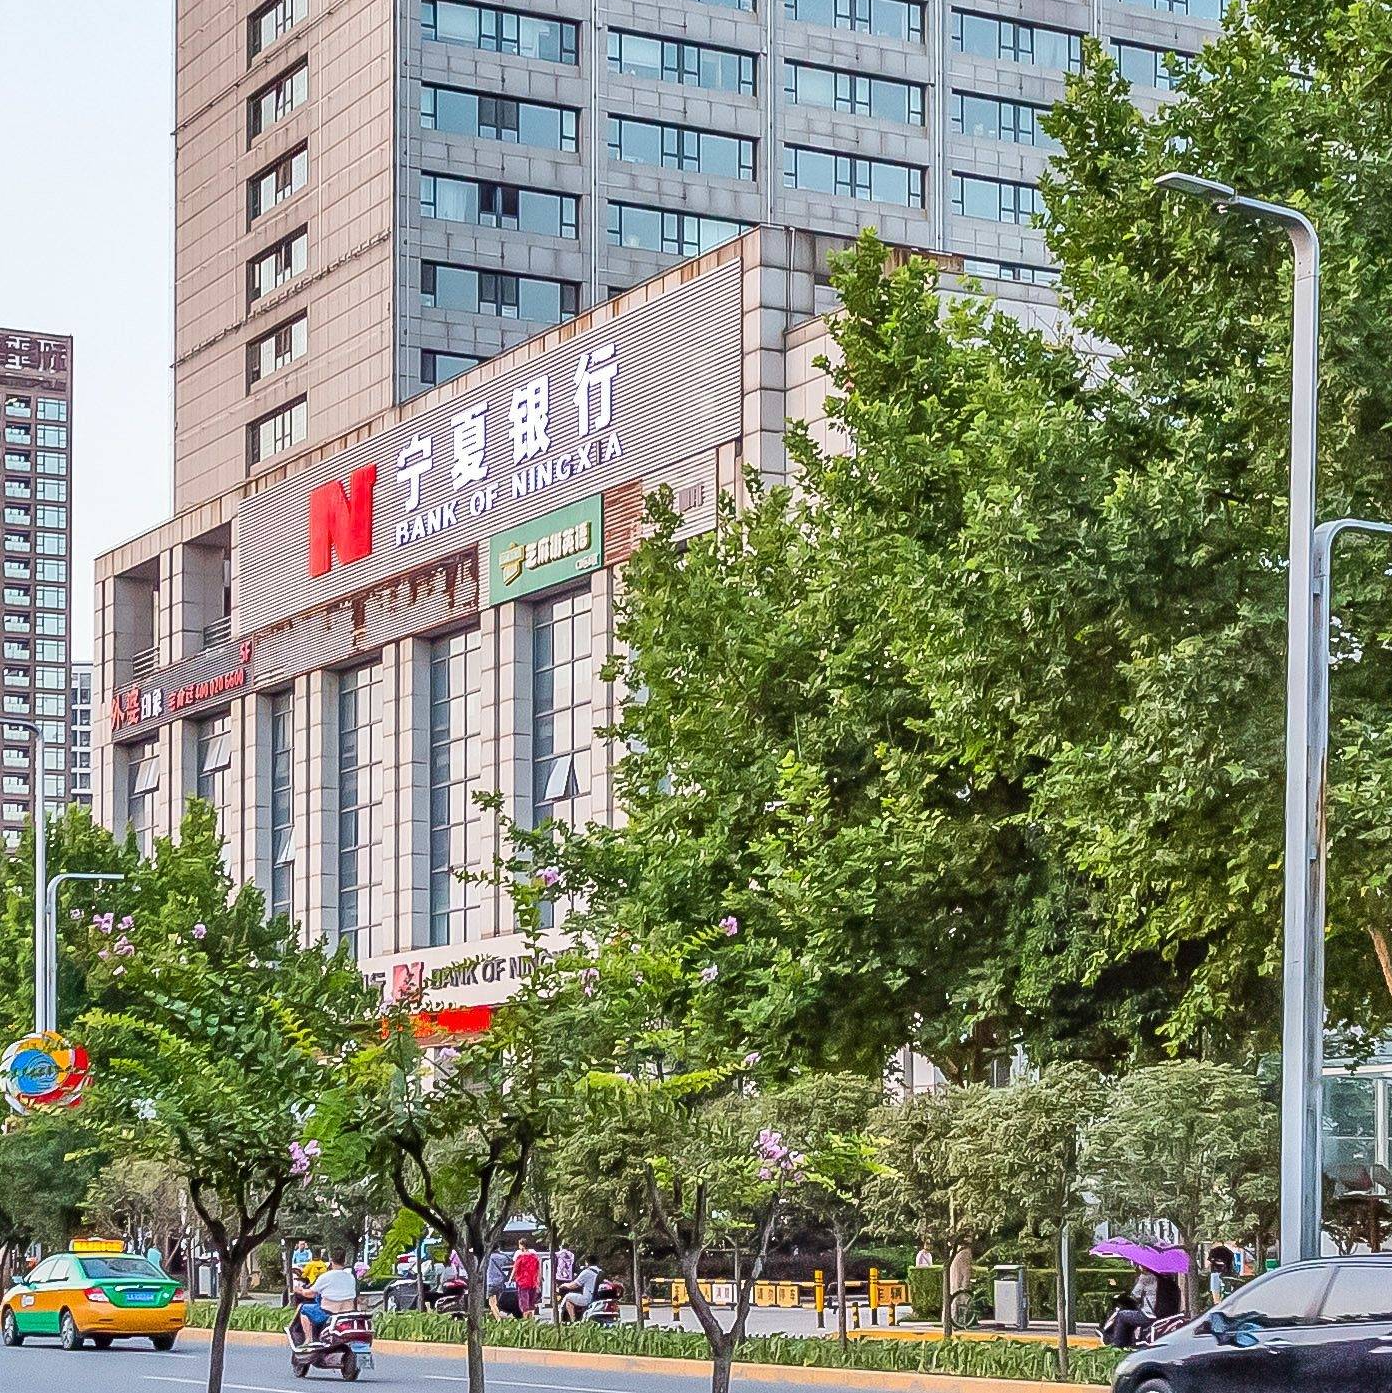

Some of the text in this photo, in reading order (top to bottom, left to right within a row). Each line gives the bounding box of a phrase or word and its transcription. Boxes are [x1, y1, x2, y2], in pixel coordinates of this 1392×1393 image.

[395, 343, 620, 513] 宁夏银行
[394, 499, 459, 546] BANK
[469, 482, 500, 516] OF
[481, 958, 507, 983] OF
